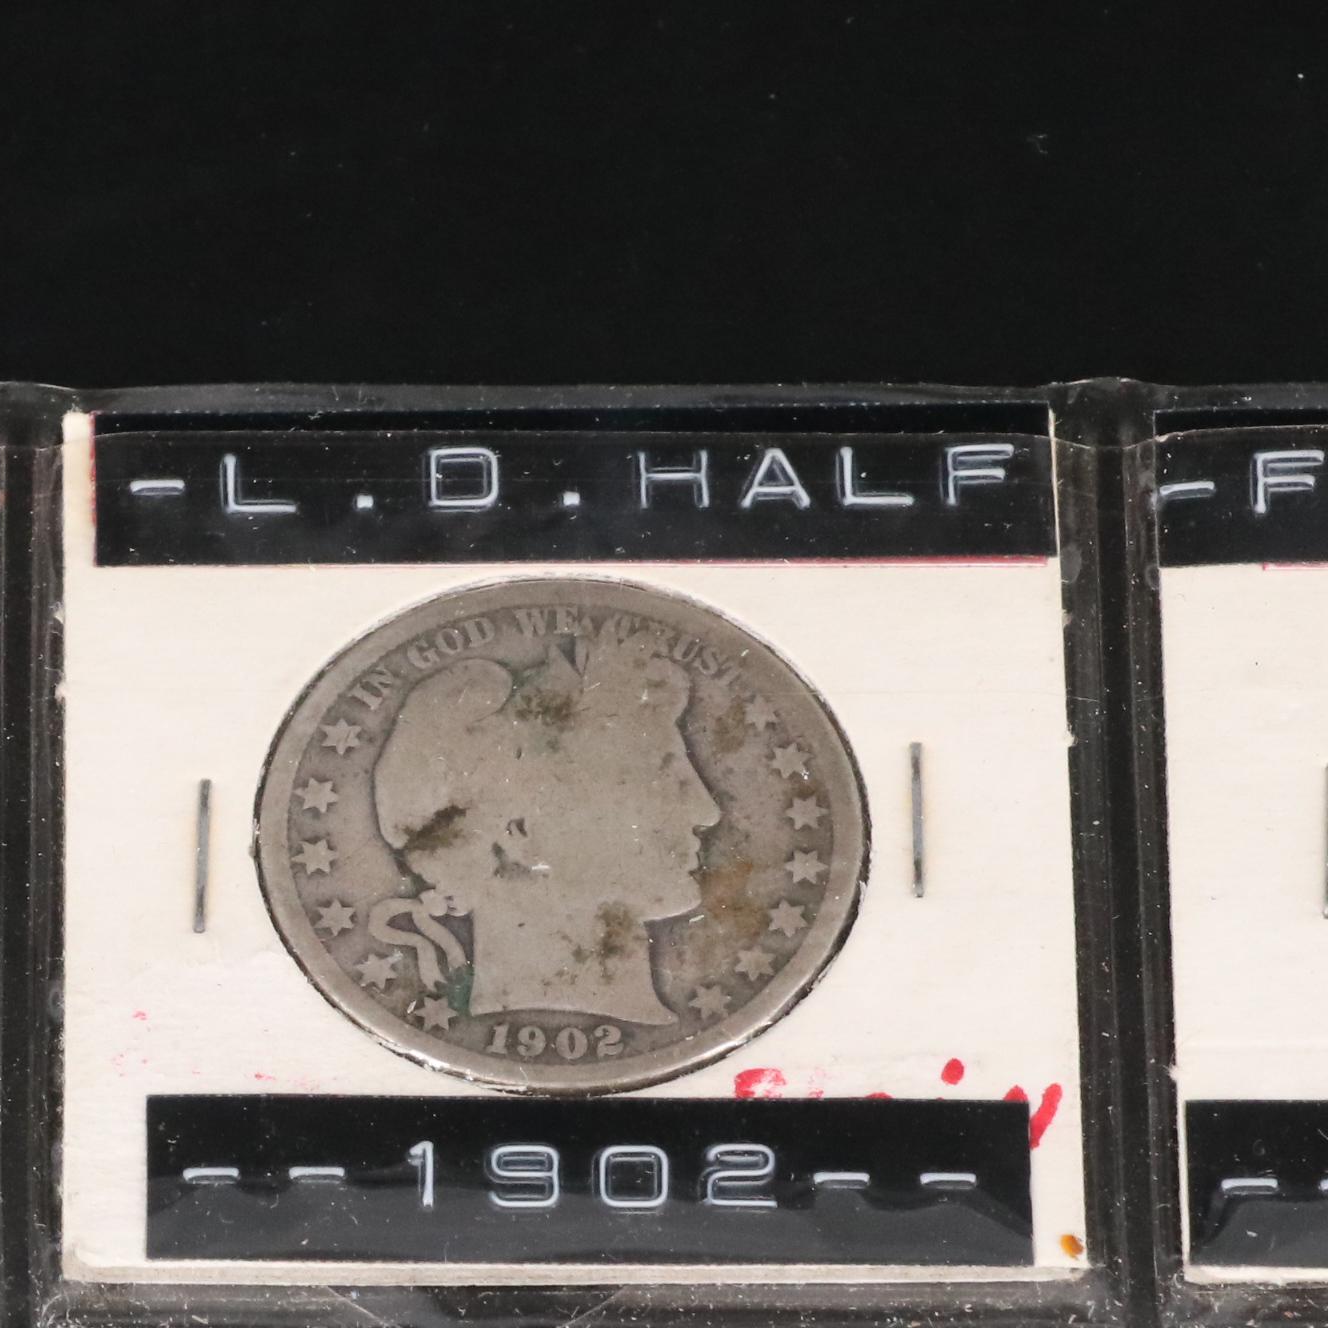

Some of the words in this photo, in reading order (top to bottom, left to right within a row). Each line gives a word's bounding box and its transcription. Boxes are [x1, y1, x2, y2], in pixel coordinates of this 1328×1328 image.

[352, 665, 396, 711] IN
[407, 617, 497, 671] GOD
[513, 606, 581, 638] WE
[485, 1021, 625, 1061] 1902
